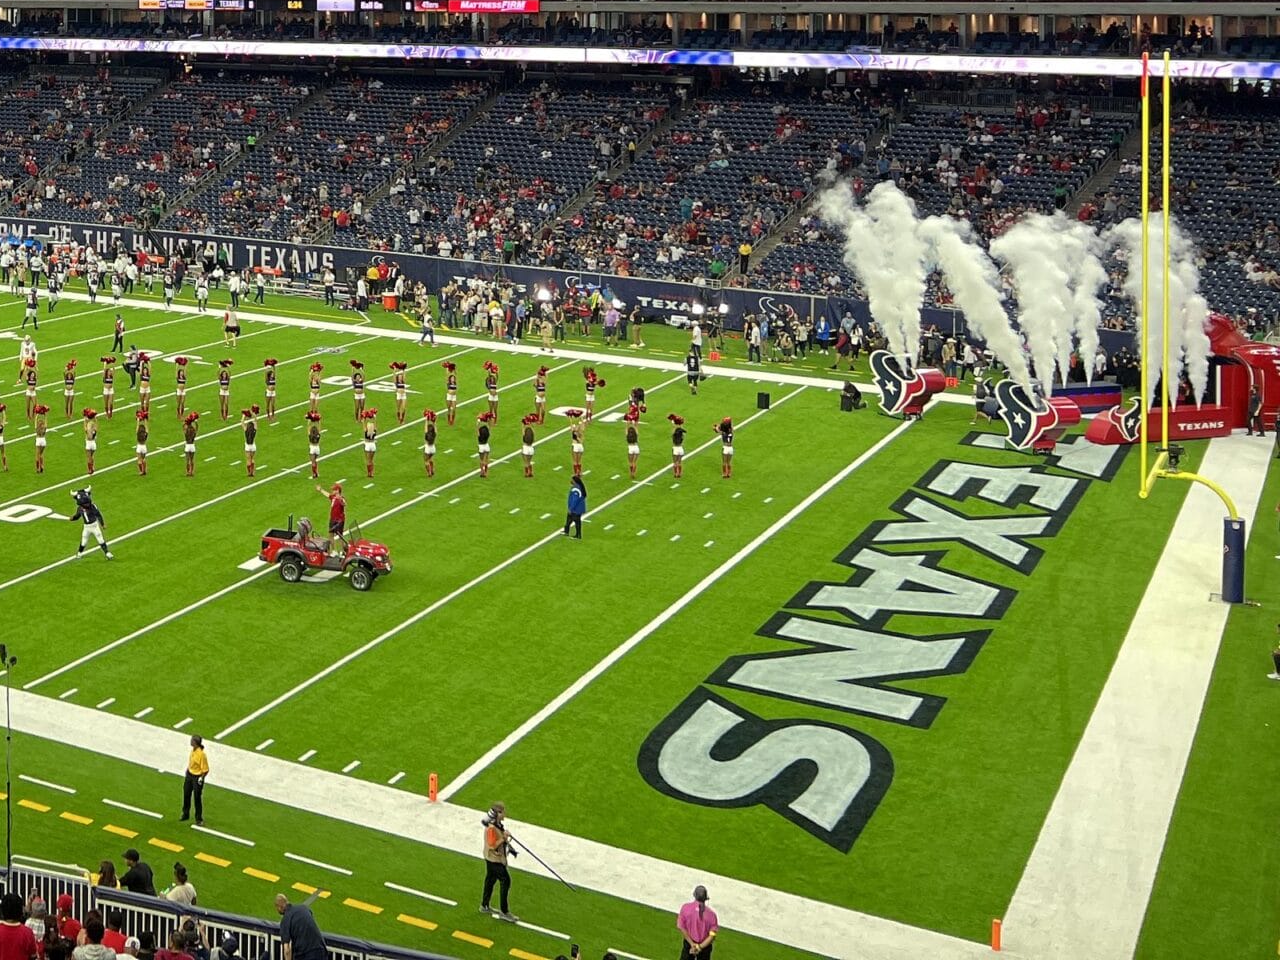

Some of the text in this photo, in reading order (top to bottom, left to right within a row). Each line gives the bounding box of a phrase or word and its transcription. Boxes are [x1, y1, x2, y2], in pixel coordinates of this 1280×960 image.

[82, 229, 122, 253] THE
[245, 244, 334, 271] TEXANS
[1178, 421, 1225, 431] TEXANS
[82, 511, 90, 525] 1
[638, 431, 1131, 854] TEXANS
